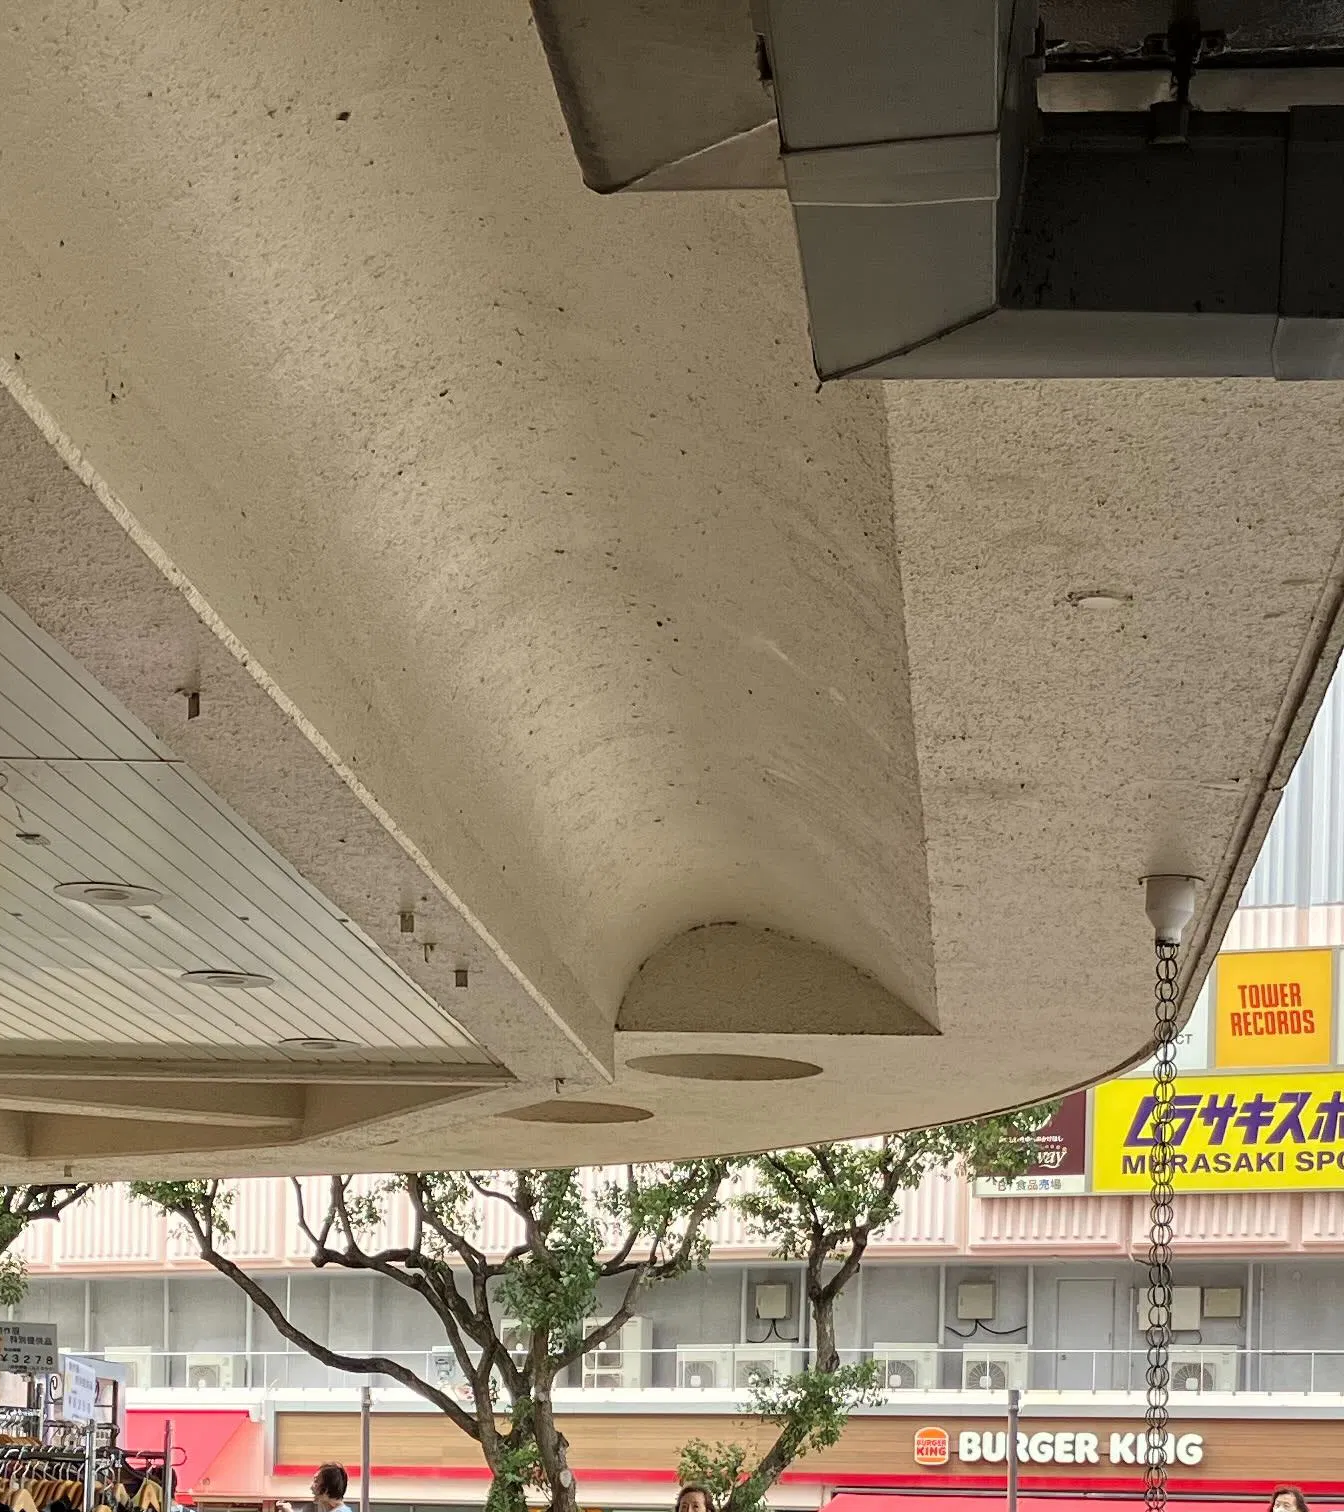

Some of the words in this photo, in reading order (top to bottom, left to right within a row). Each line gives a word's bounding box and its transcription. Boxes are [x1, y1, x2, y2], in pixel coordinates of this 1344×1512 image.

[1238, 983, 1302, 1008] TOWER
[1230, 1009, 1315, 1036] RECORDS
[916, 1439, 947, 1447] BURGER
[916, 1447, 947, 1457] KING
[959, 1431, 1101, 1464] BURGER
